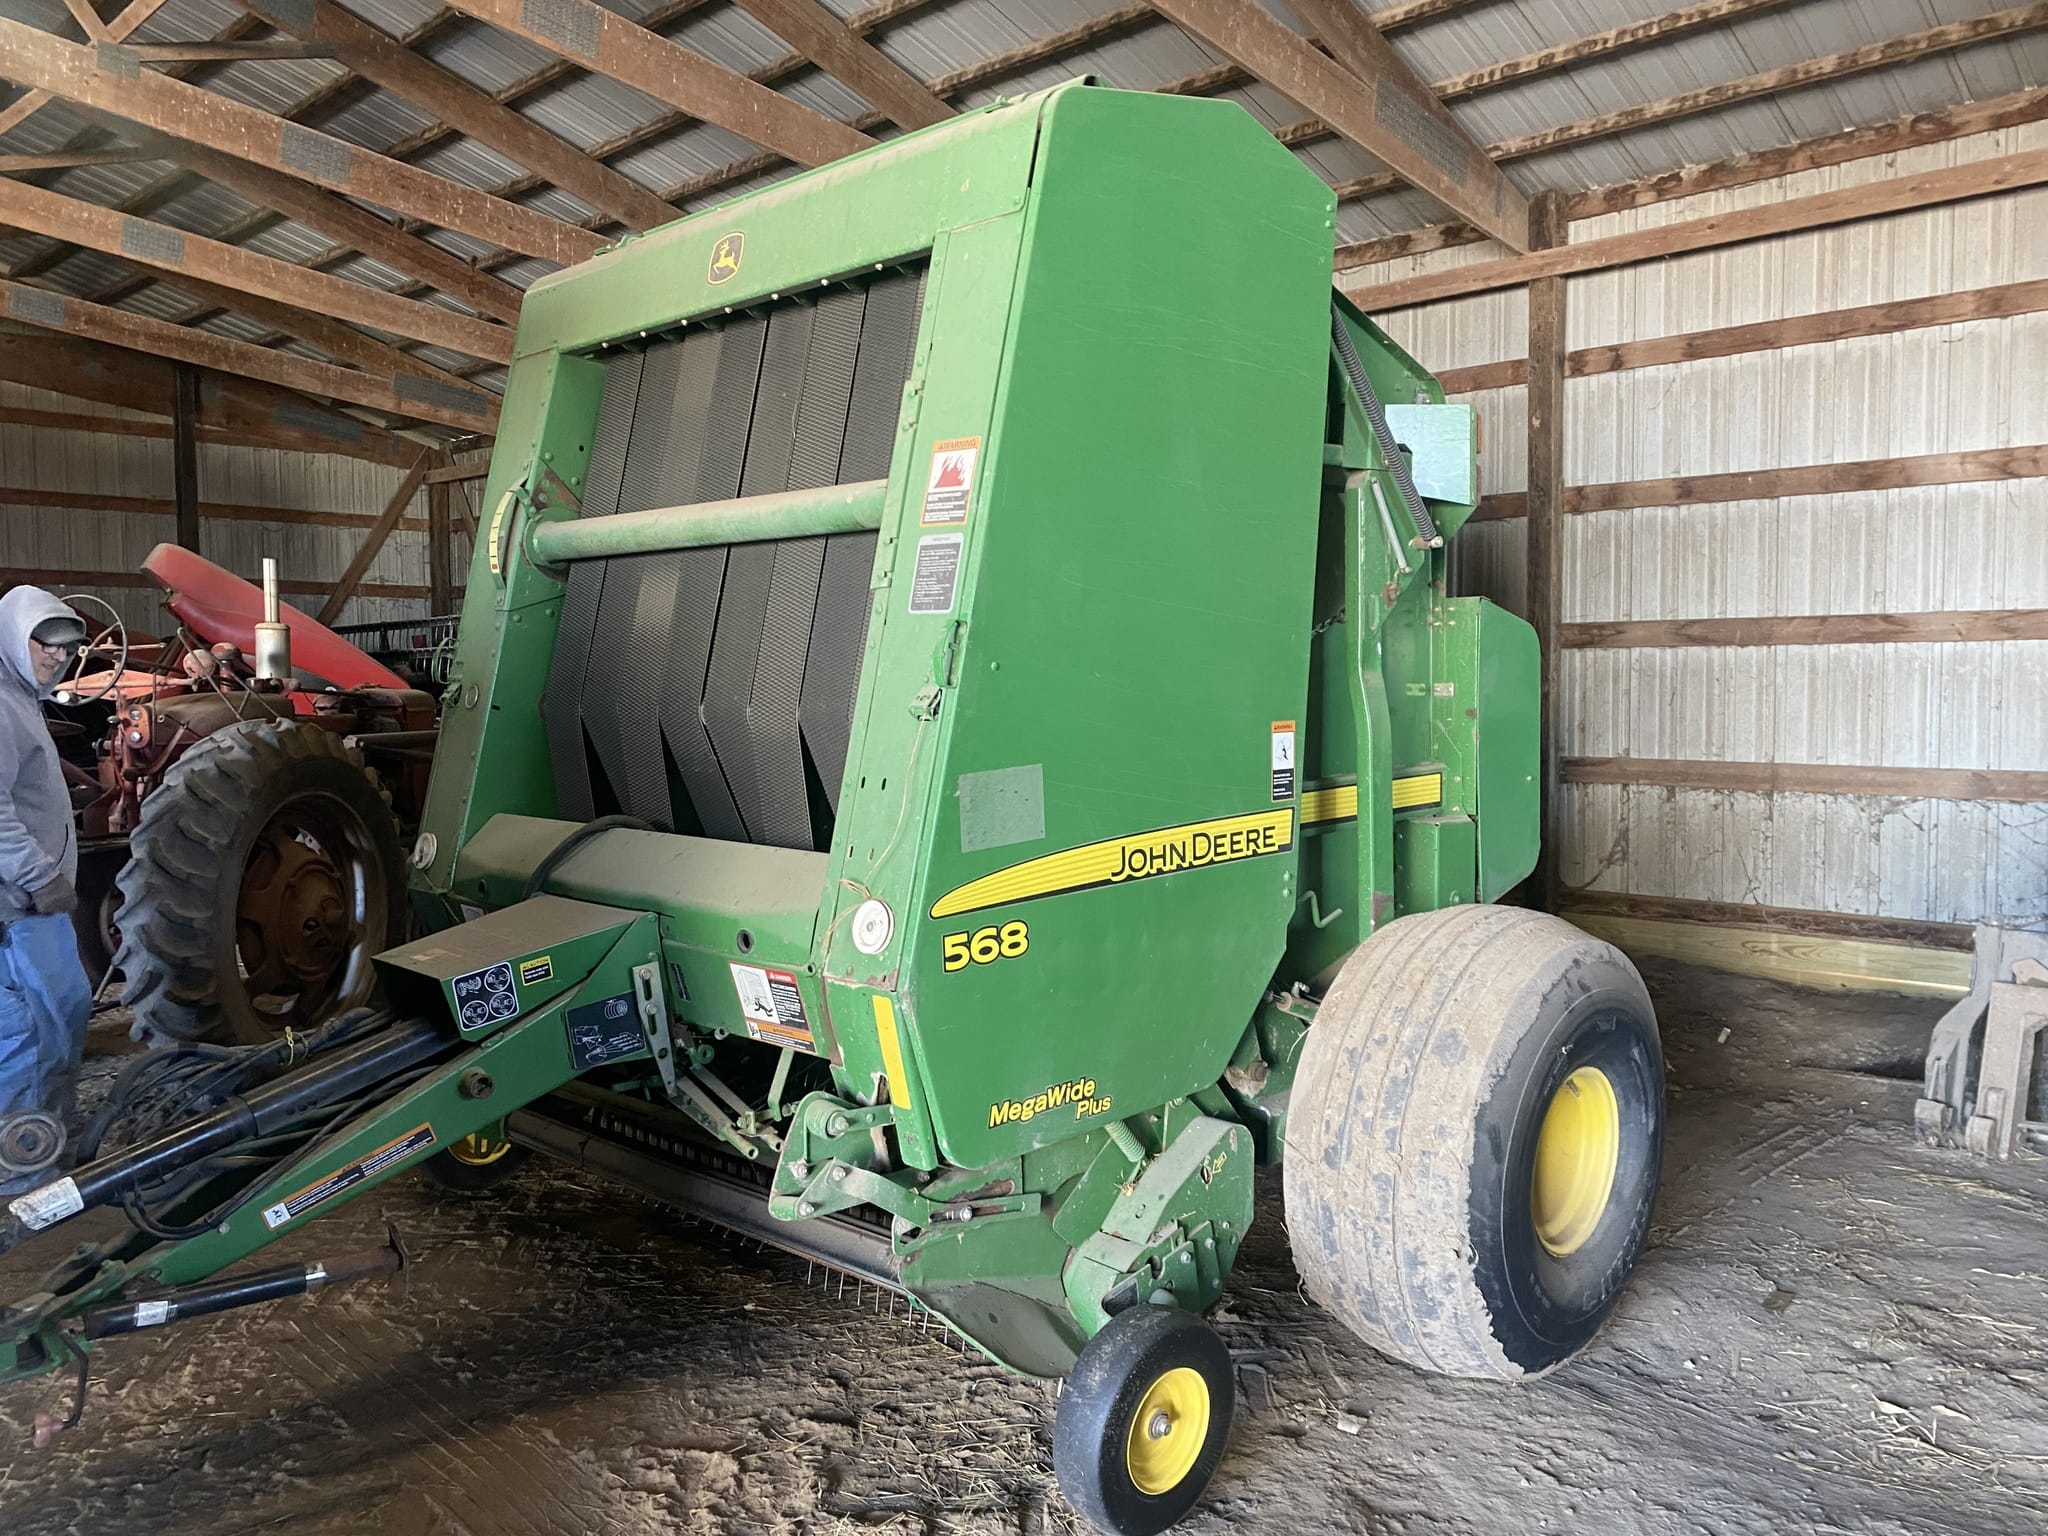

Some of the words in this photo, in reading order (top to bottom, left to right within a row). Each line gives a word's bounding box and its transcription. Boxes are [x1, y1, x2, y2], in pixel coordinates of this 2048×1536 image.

[1111, 841, 1186, 877] JOHN
[1193, 826, 1276, 862] DEERE
[943, 920, 1029, 973] 568
[988, 1077, 1096, 1128] MegaWide
[1076, 1097, 1112, 1120] Plus
